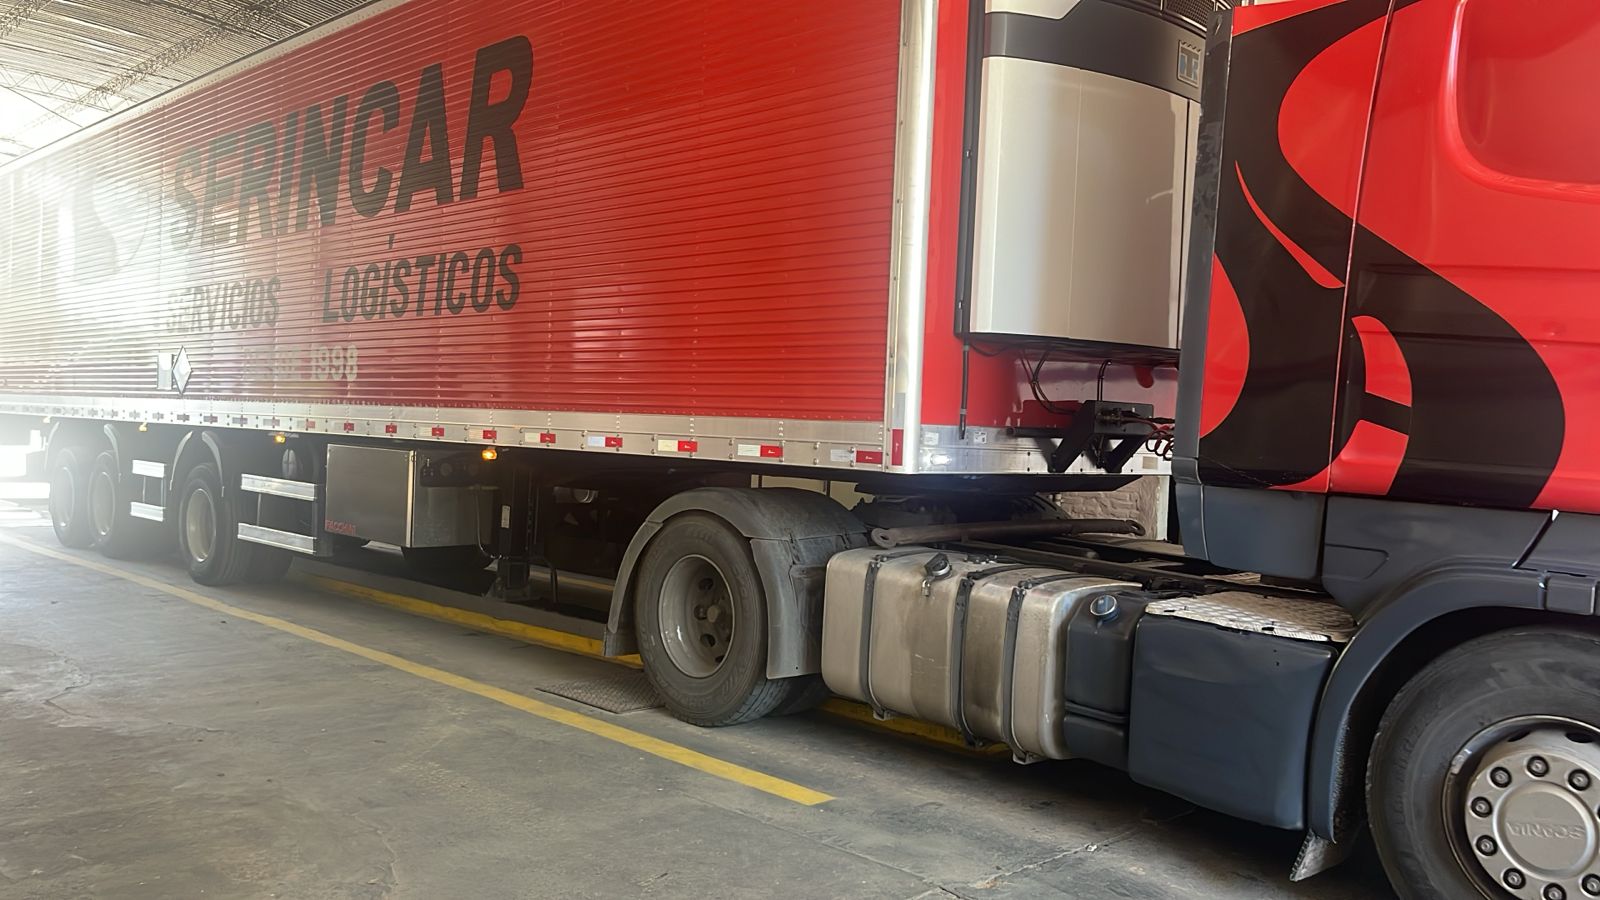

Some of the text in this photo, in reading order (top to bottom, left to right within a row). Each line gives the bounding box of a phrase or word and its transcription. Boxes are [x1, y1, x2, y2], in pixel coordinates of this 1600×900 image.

[172, 35, 534, 247] SERINCAR
[167, 234, 524, 334] SERVICIOS LOGÍSTICOS
[310, 344, 358, 381] 1998
[1505, 821, 1586, 840] SCANIA
